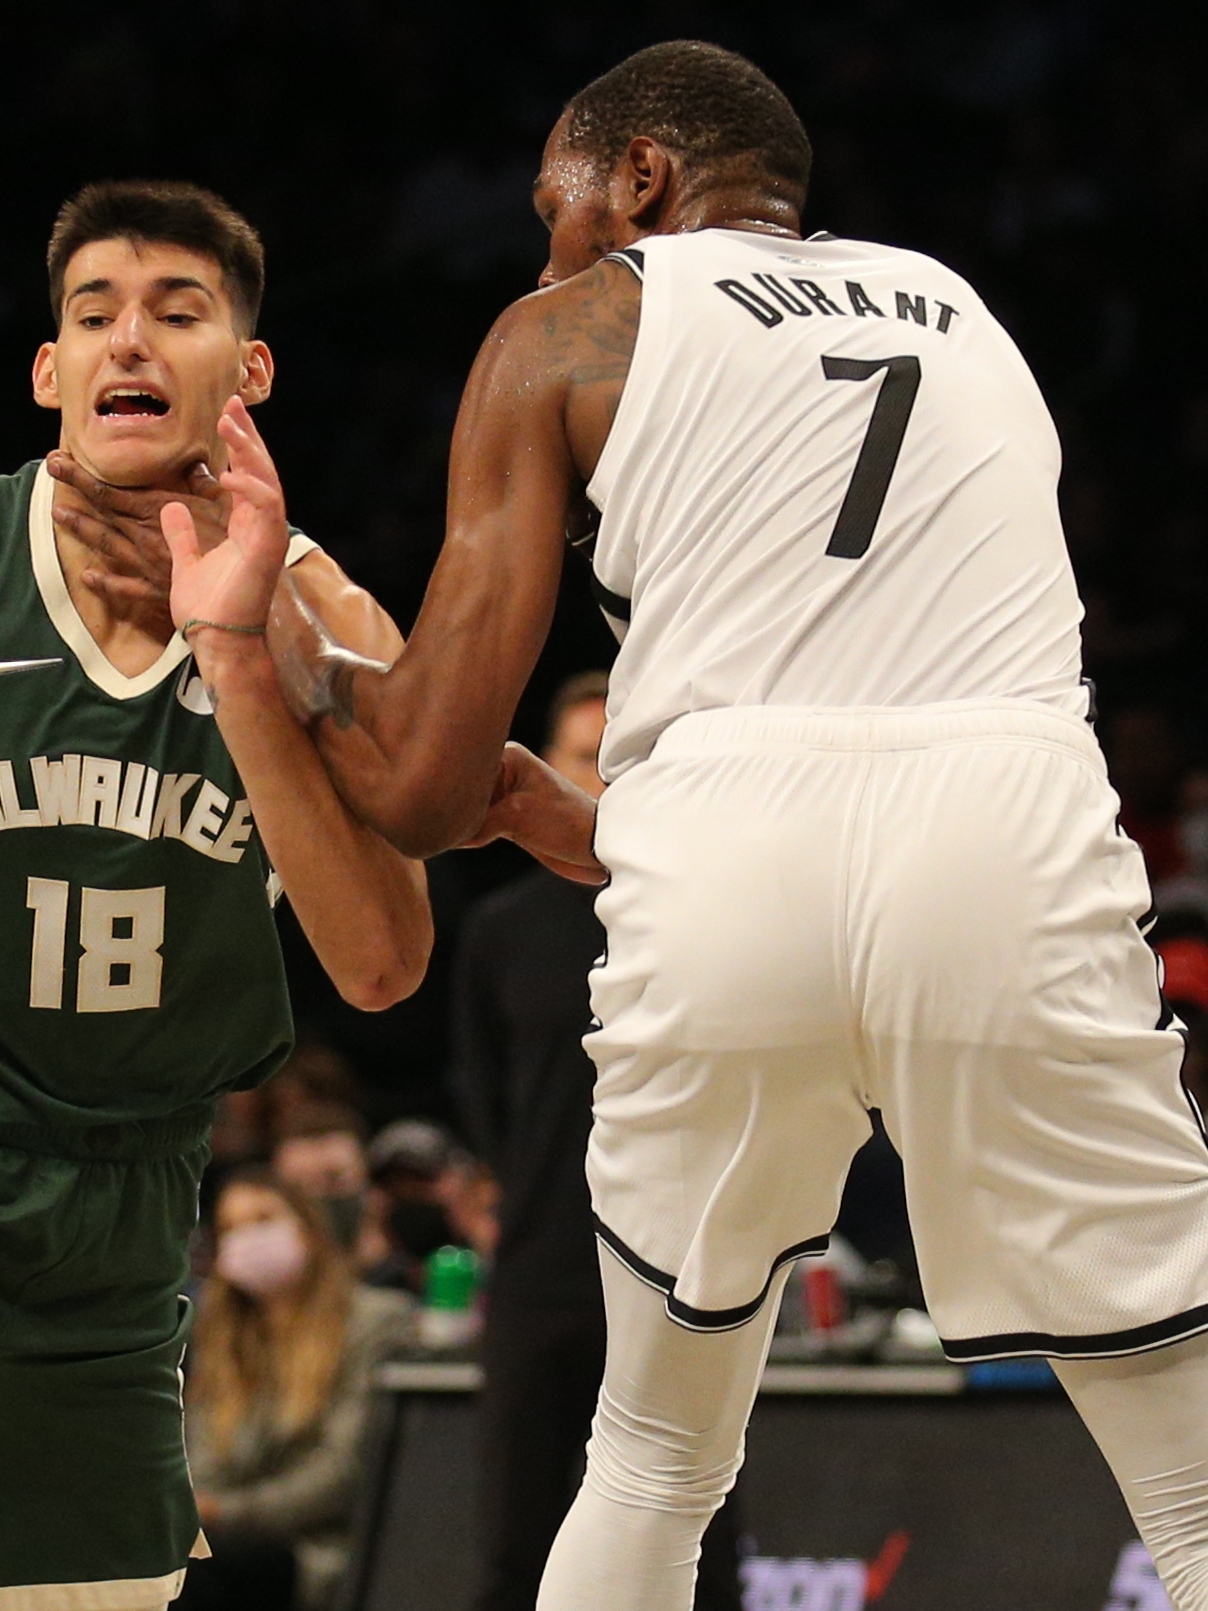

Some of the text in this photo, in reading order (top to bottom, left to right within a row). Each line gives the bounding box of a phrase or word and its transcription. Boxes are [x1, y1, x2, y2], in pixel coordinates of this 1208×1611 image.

[714, 273, 960, 334] DURANT
[821, 355, 922, 559] 7
[26, 876, 166, 1013] 18
